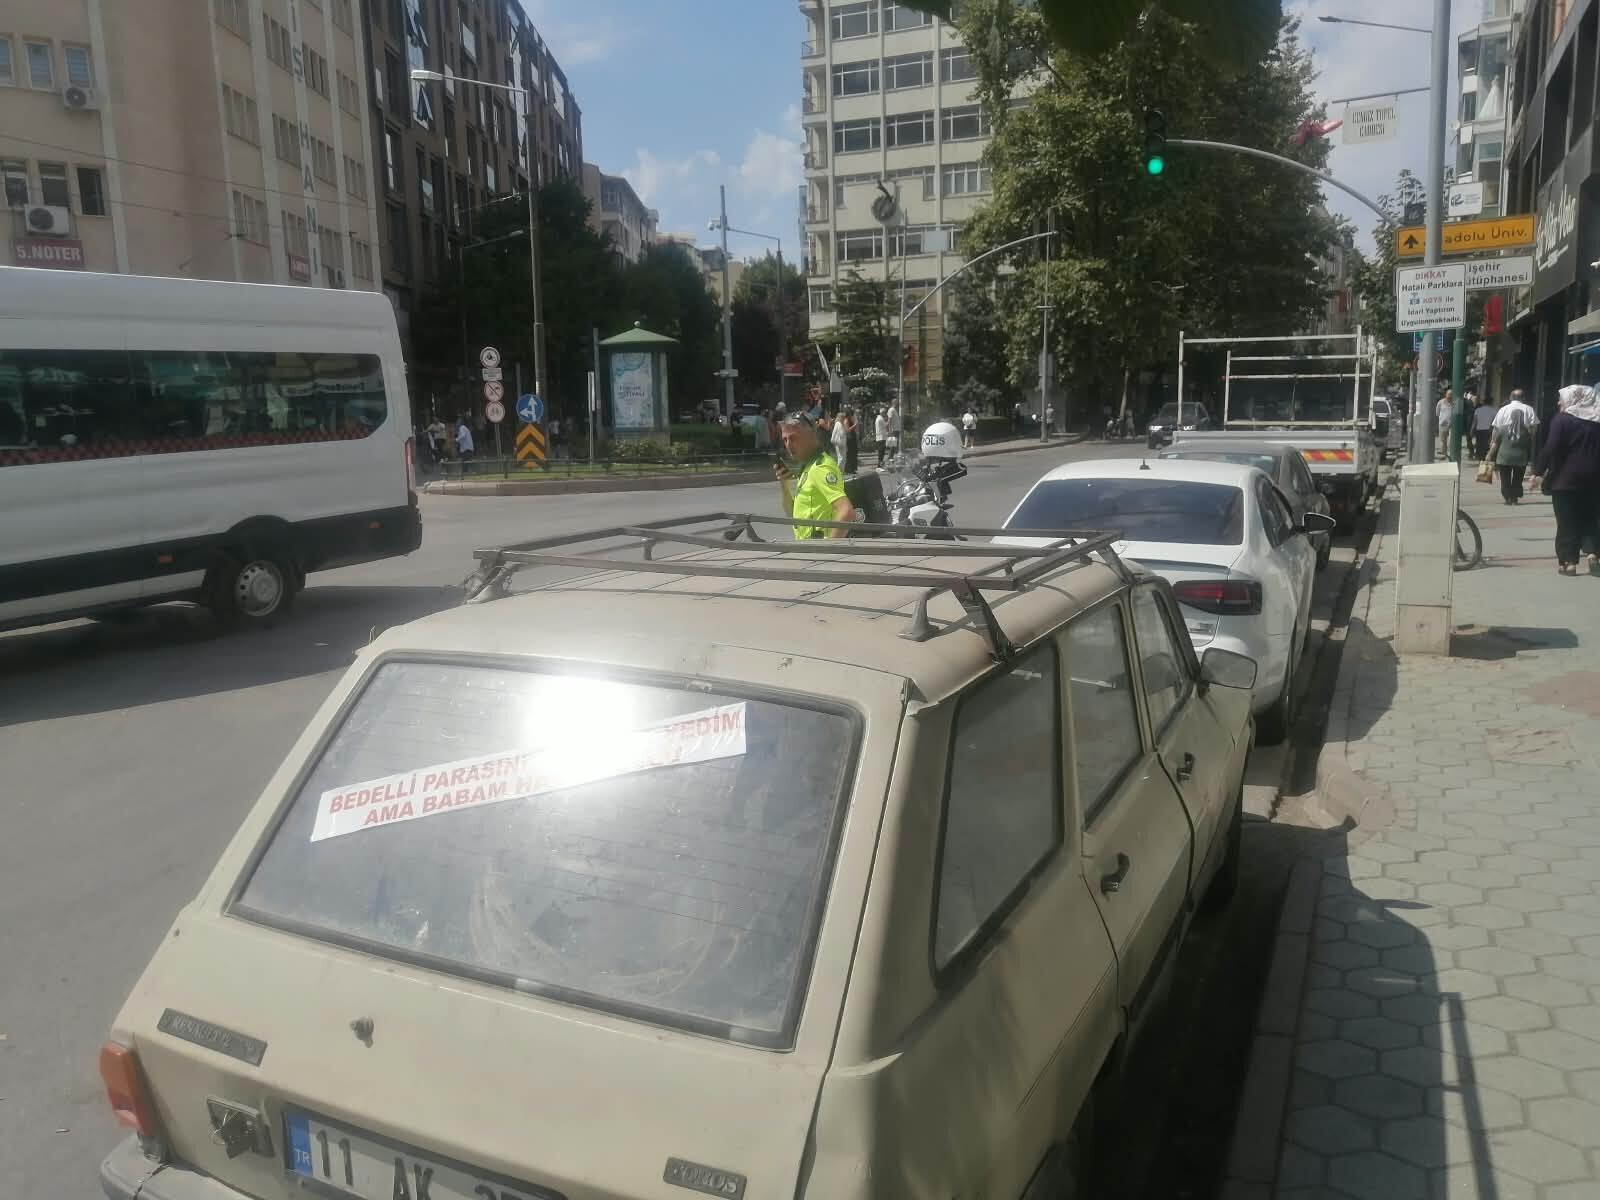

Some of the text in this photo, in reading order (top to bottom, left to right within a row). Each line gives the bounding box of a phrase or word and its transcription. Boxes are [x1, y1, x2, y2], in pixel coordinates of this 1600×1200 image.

[16, 245, 81, 261] 5.NOTER
[1468, 263, 1501, 273] işehir
[1427, 280, 1463, 289] Parklara
[329, 773, 417, 814] BEDELLİ
[363, 801, 414, 826] AMA
[421, 781, 507, 813] BABAM
[295, 1149, 310, 1164] TR
[316, 1129, 434, 1200] 11 AK
